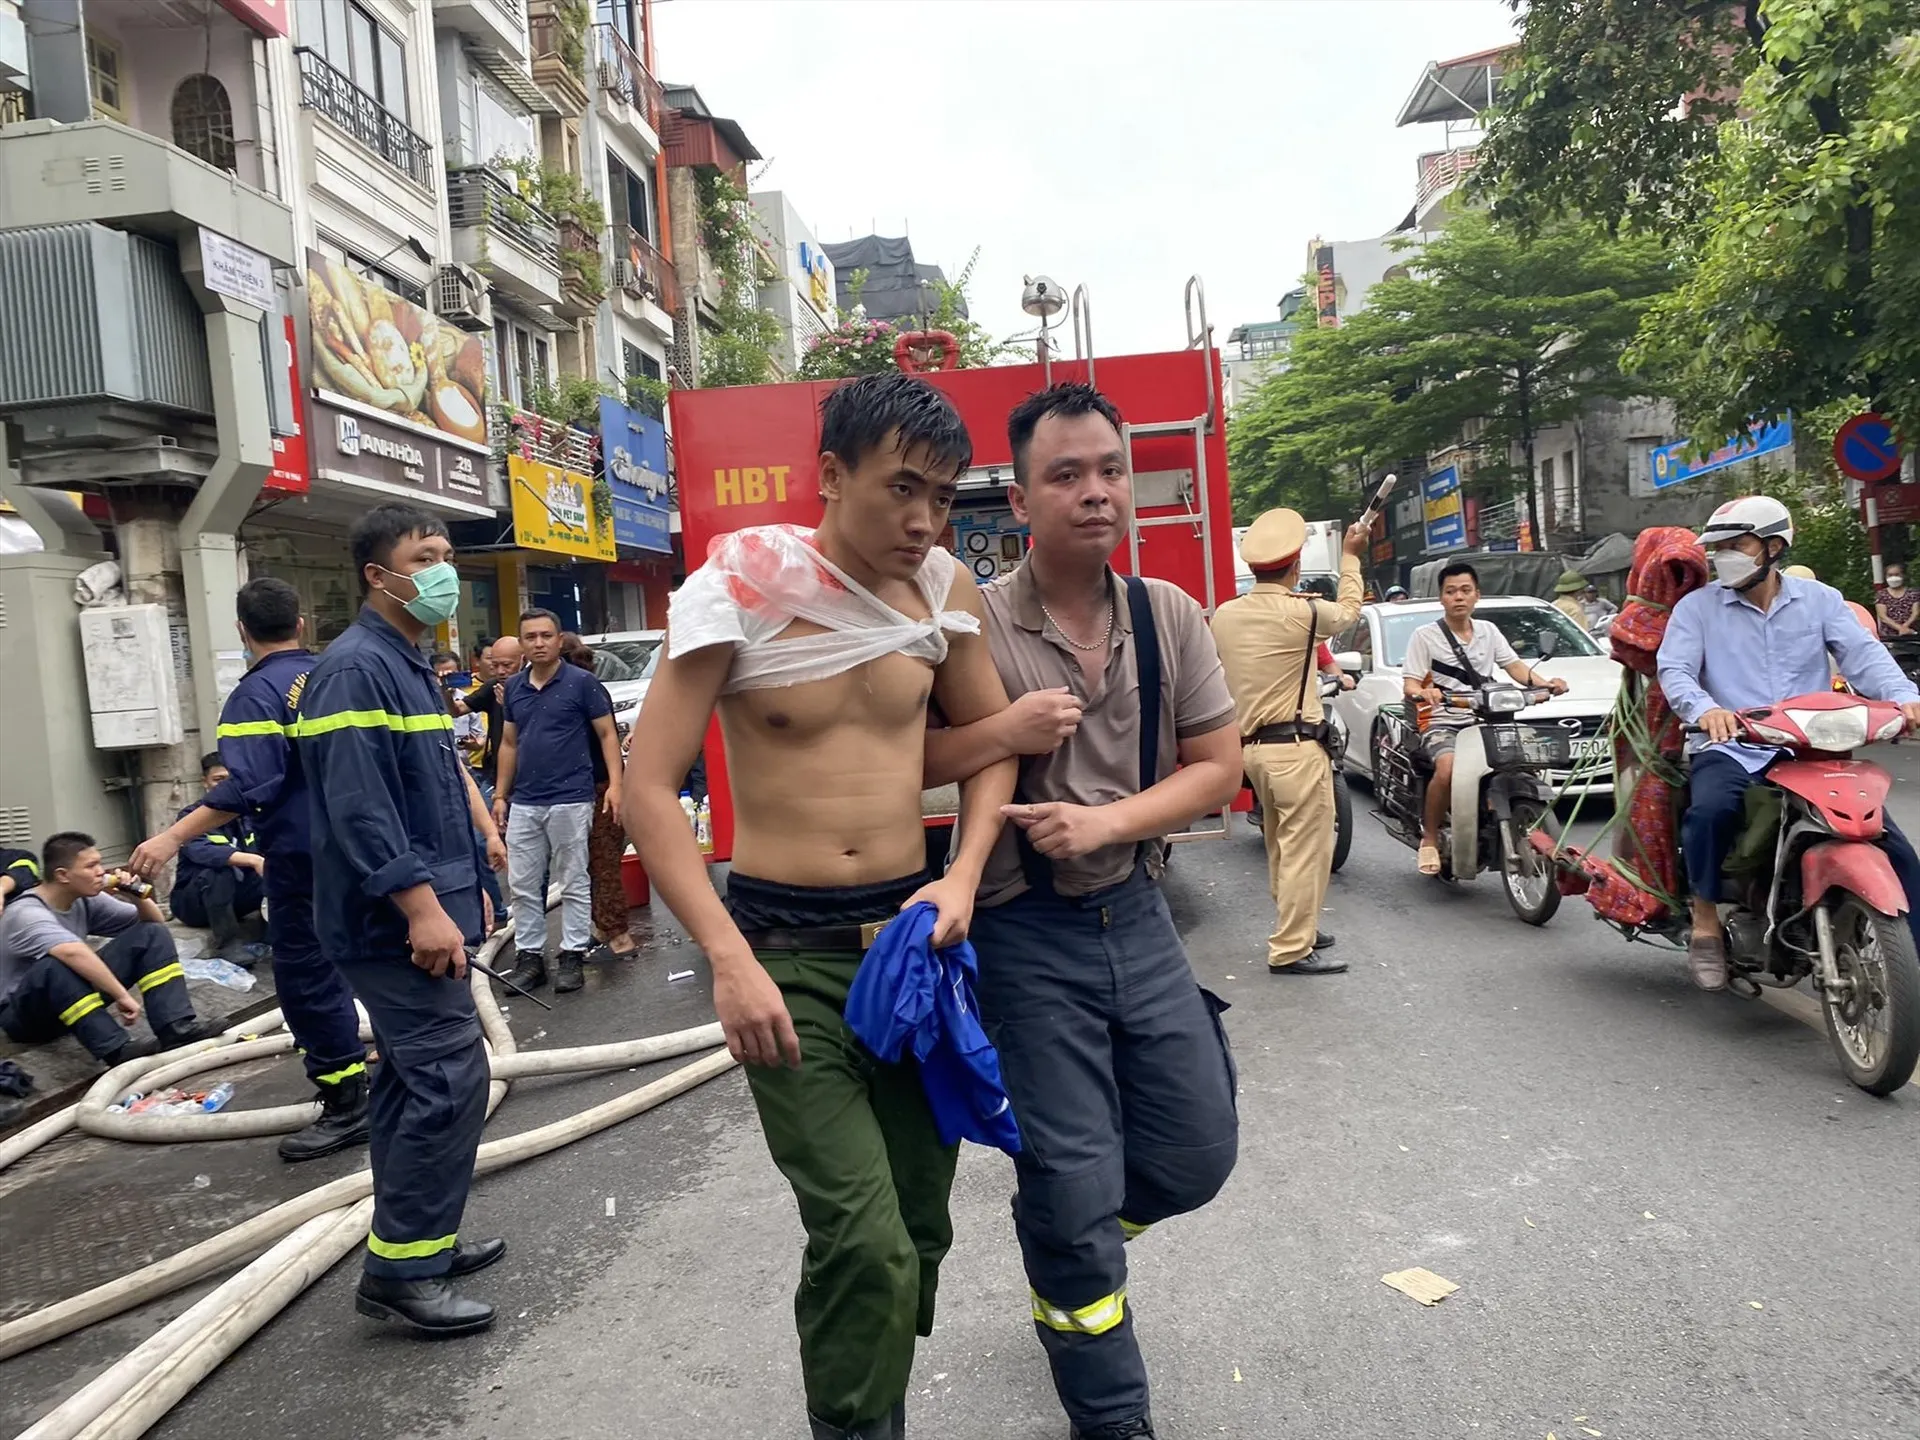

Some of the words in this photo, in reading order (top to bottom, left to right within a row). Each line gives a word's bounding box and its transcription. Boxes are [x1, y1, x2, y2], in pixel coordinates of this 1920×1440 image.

[360, 433, 394, 459] ANH
[395, 443, 425, 467] HÒA
[713, 465, 791, 506] HBT
[563, 509, 573, 520] PET
[285, 683, 302, 710] CẢNH
